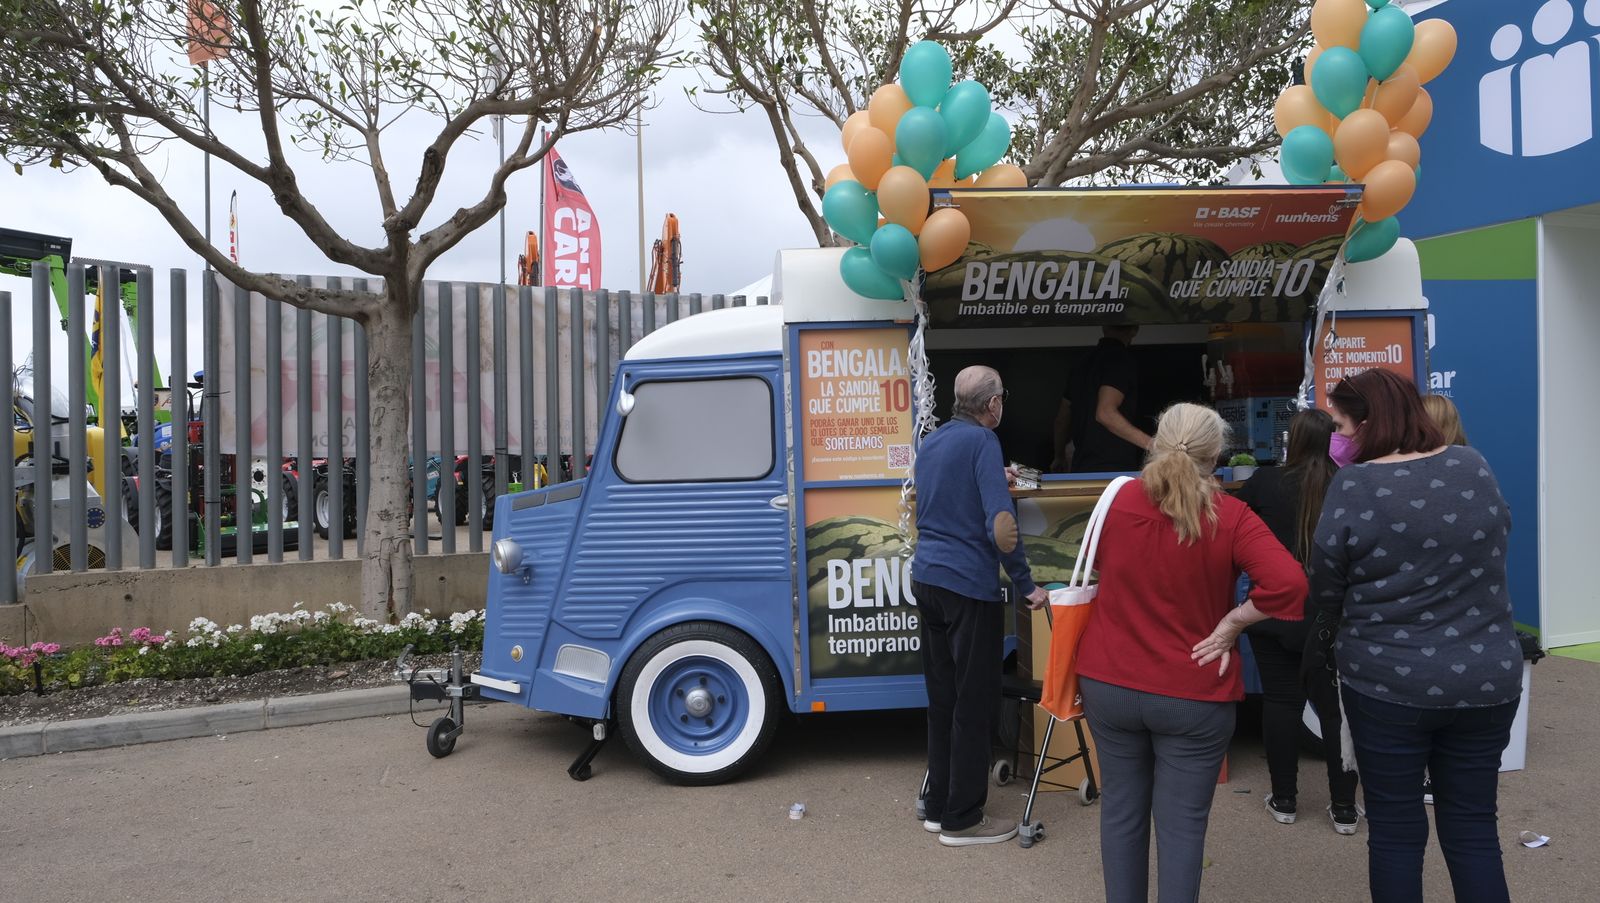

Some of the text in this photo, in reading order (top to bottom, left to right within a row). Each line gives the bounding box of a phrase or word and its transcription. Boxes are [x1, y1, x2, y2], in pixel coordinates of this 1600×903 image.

[1218, 207, 1261, 219] BASF
[1275, 212, 1340, 223] nunhems
[554, 207, 578, 289] CAR
[1192, 256, 1276, 279] LA SANDÍA
[961, 260, 1120, 301] BENGALA
[1169, 258, 1316, 299] QUE CUMPLE 10
[958, 302, 1124, 316] Imbatible en temprano
[821, 341, 834, 350] CON
[1324, 336, 1366, 349] CMPARTE
[807, 348, 903, 378] BENGALA
[1324, 344, 1403, 364] ESTE MOMENTO 10
[1325, 367, 1342, 379] CON
[809, 379, 909, 415] QUE CUMPLE 10
[820, 377, 880, 397] LA SANDÍA
[810, 417, 897, 428] PODRÁS GANAR UNO DE LOS
[819, 428, 837, 436] LOTES
[840, 428, 848, 436] DE
[850, 427, 868, 435] 2.000
[870, 426, 899, 435] SEMILLAS
[811, 436, 883, 451] QUE SORTEAMOS
[828, 611, 919, 633] Imbatible
[828, 636, 921, 657] temprano
